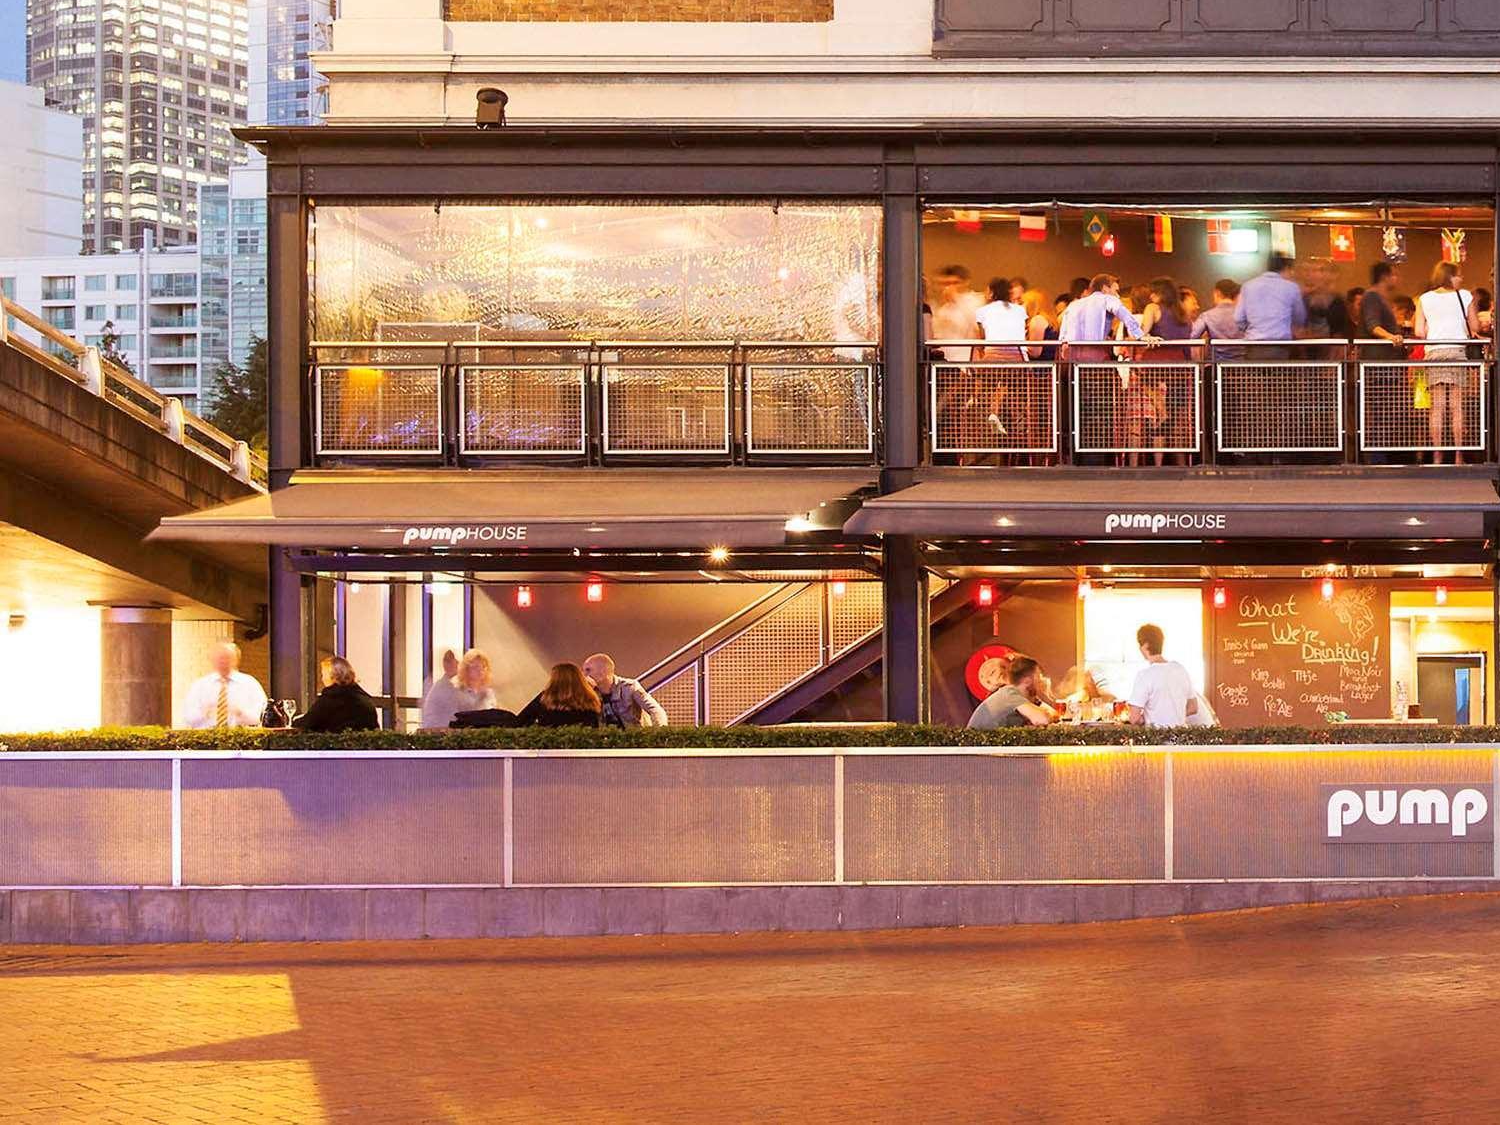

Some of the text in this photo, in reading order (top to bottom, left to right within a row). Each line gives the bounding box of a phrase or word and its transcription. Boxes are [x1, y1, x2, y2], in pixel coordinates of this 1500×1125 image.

[1239, 594, 1299, 618] What
[1271, 622, 1319, 644] We're
[1327, 788, 1488, 837] pump
